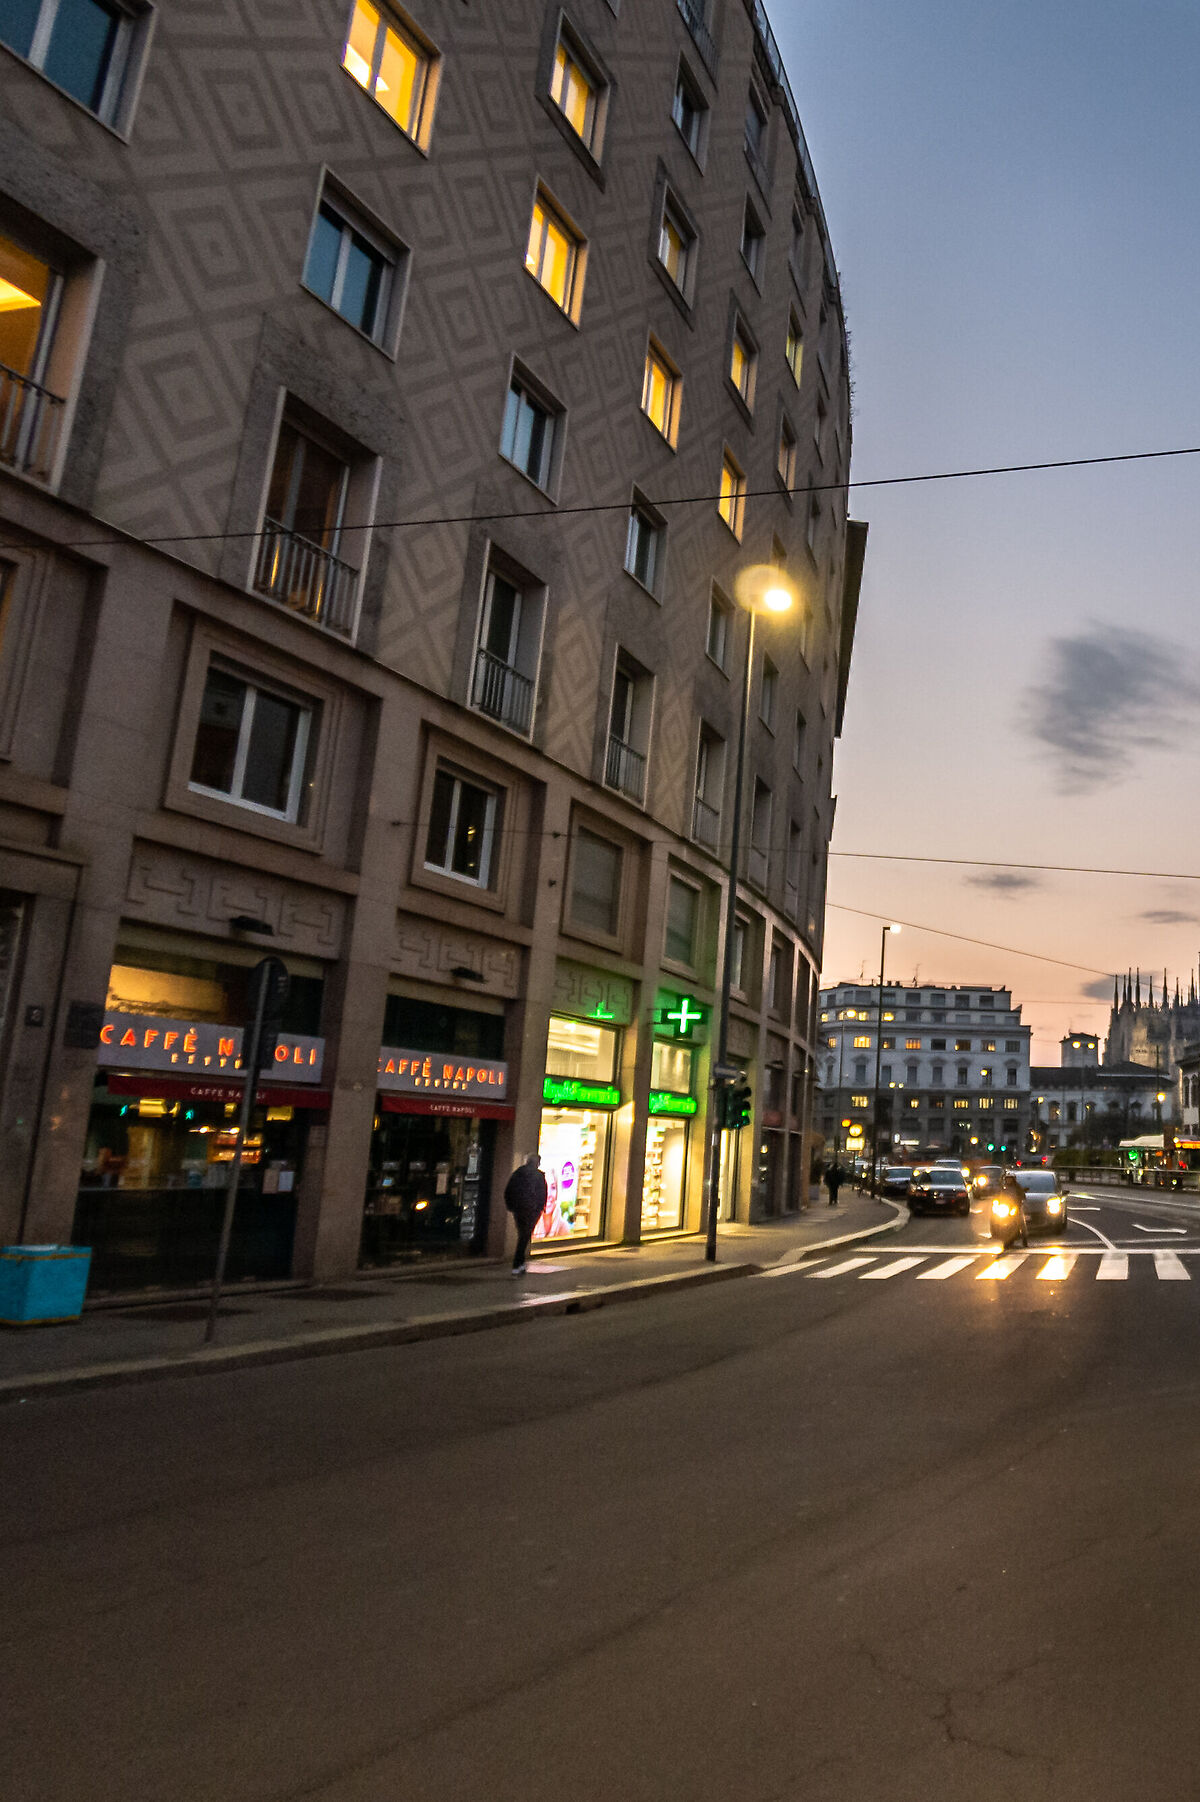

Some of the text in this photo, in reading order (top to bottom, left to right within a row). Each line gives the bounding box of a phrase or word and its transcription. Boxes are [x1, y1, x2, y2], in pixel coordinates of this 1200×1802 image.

[99, 1024, 198, 1053] CAFFÈ
[218, 1037, 317, 1065] NOLI
[443, 1064, 504, 1085] NAPOLI
